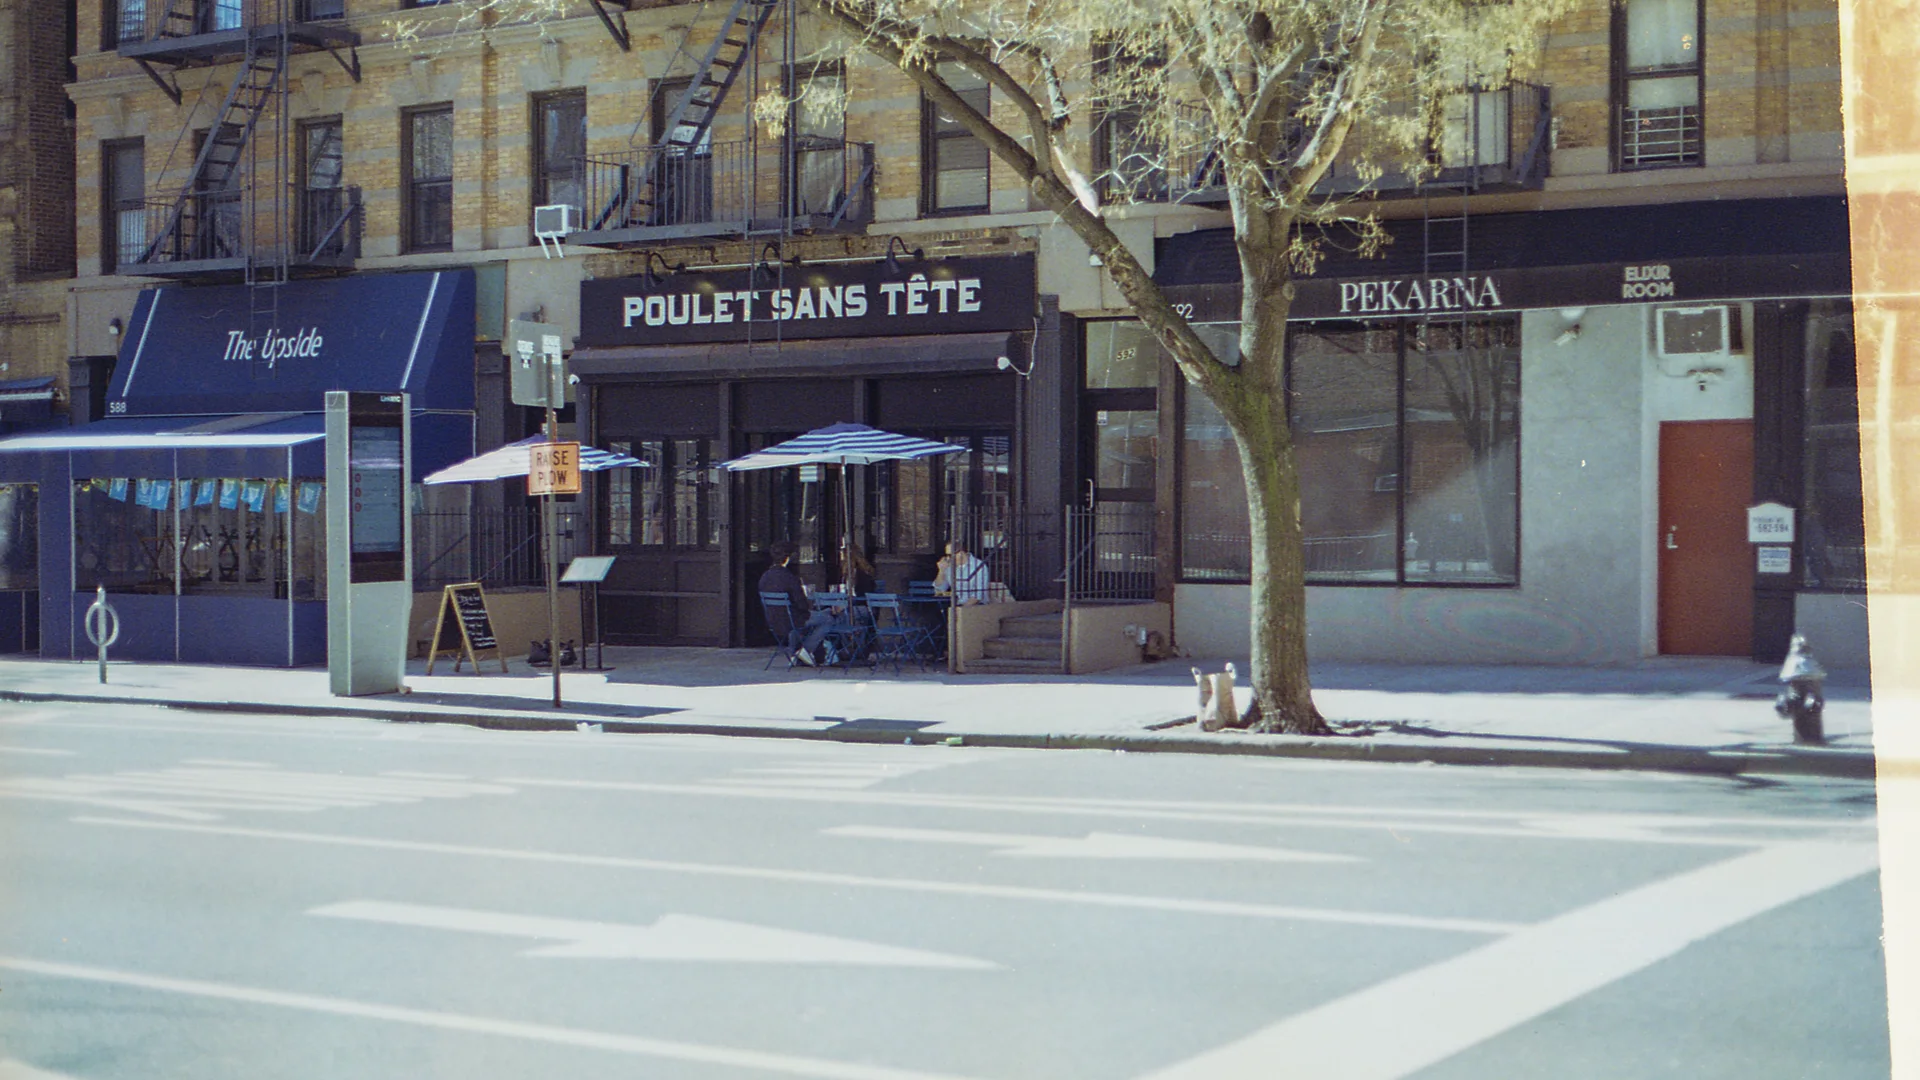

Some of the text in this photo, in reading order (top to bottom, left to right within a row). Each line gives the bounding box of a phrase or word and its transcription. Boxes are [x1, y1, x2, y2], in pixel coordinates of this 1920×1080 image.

[1624, 265, 1671, 281] ELIXIR
[1339, 275, 1502, 313] PEKARNA
[1623, 281, 1674, 298] ROOM
[623, 273, 981, 327] POULET SANS TÊTE
[1171, 303, 1194, 319] 92
[223, 327, 323, 369] The Upside
[1116, 348, 1136, 361] 592
[109, 402, 126, 413] 588
